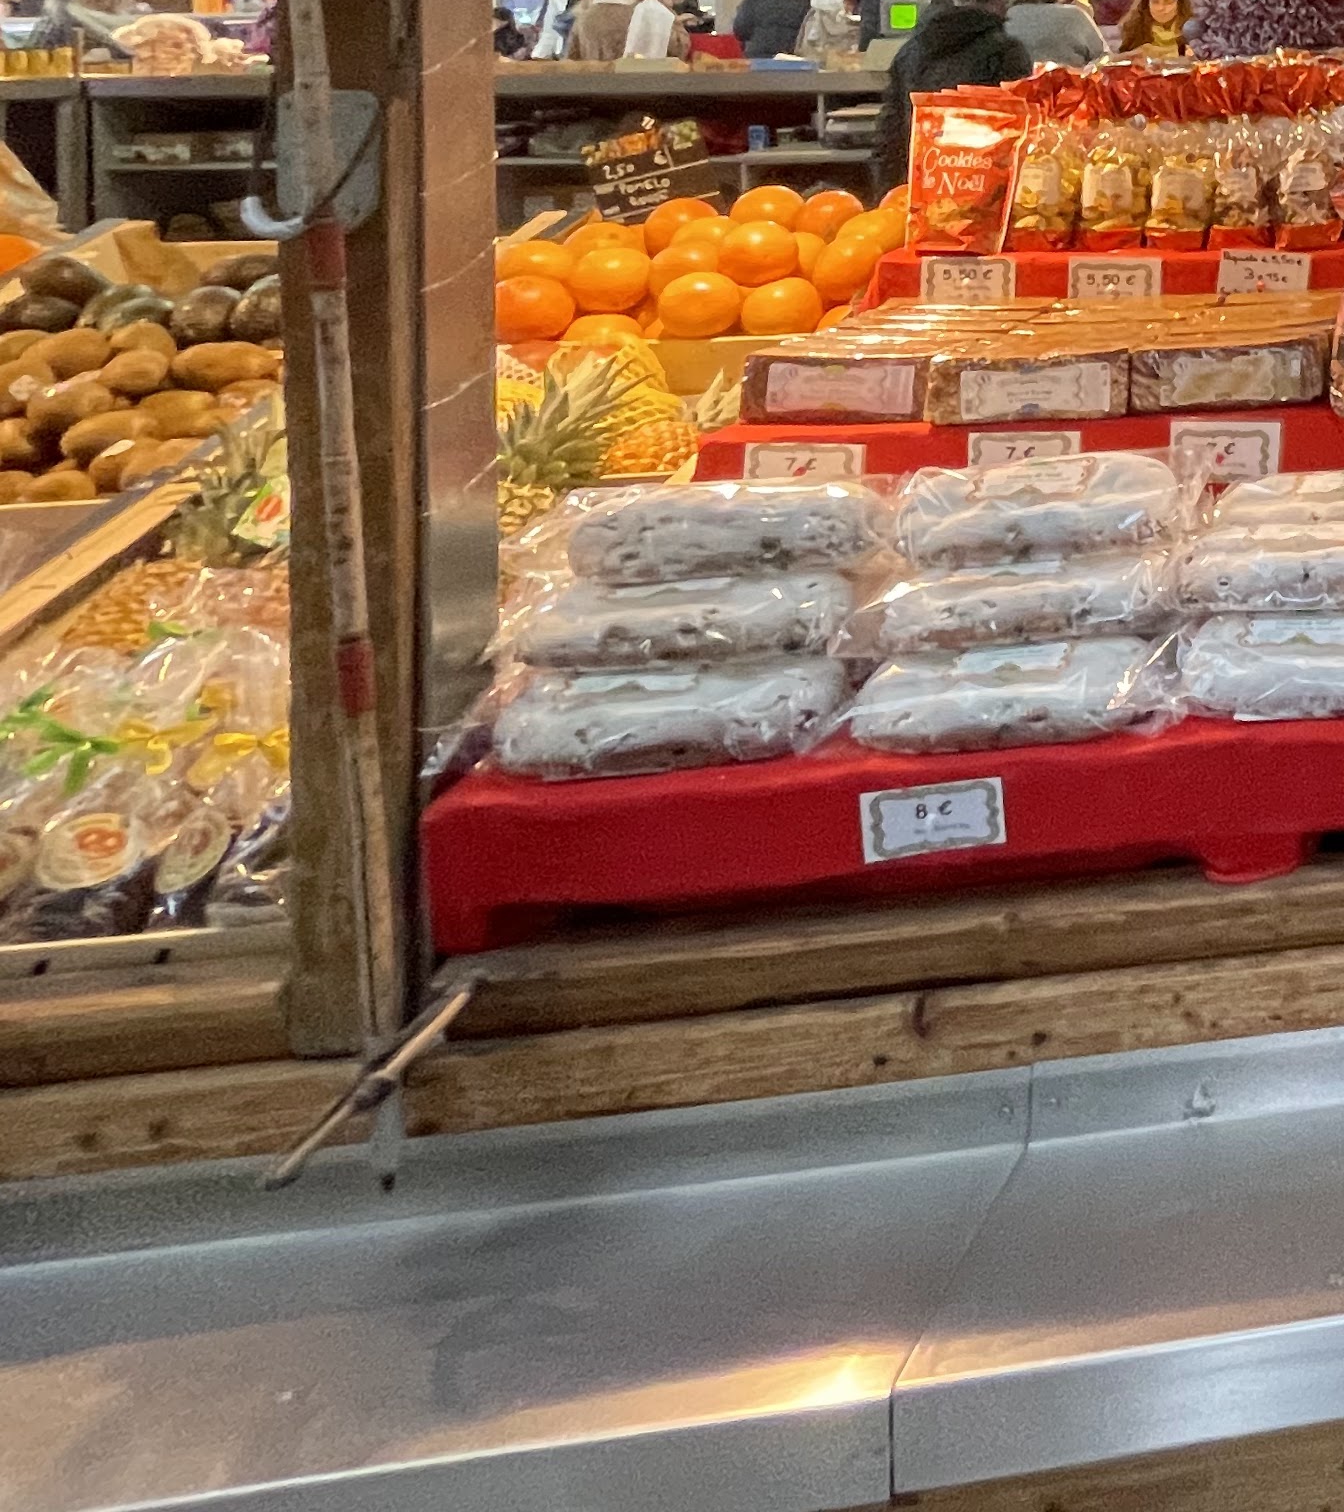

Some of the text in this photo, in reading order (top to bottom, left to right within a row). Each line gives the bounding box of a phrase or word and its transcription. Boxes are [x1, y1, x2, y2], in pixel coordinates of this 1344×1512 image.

[922, 145, 994, 176] Cookies
[783, 456, 798, 472] 7
[915, 799, 953, 820] 8 €
